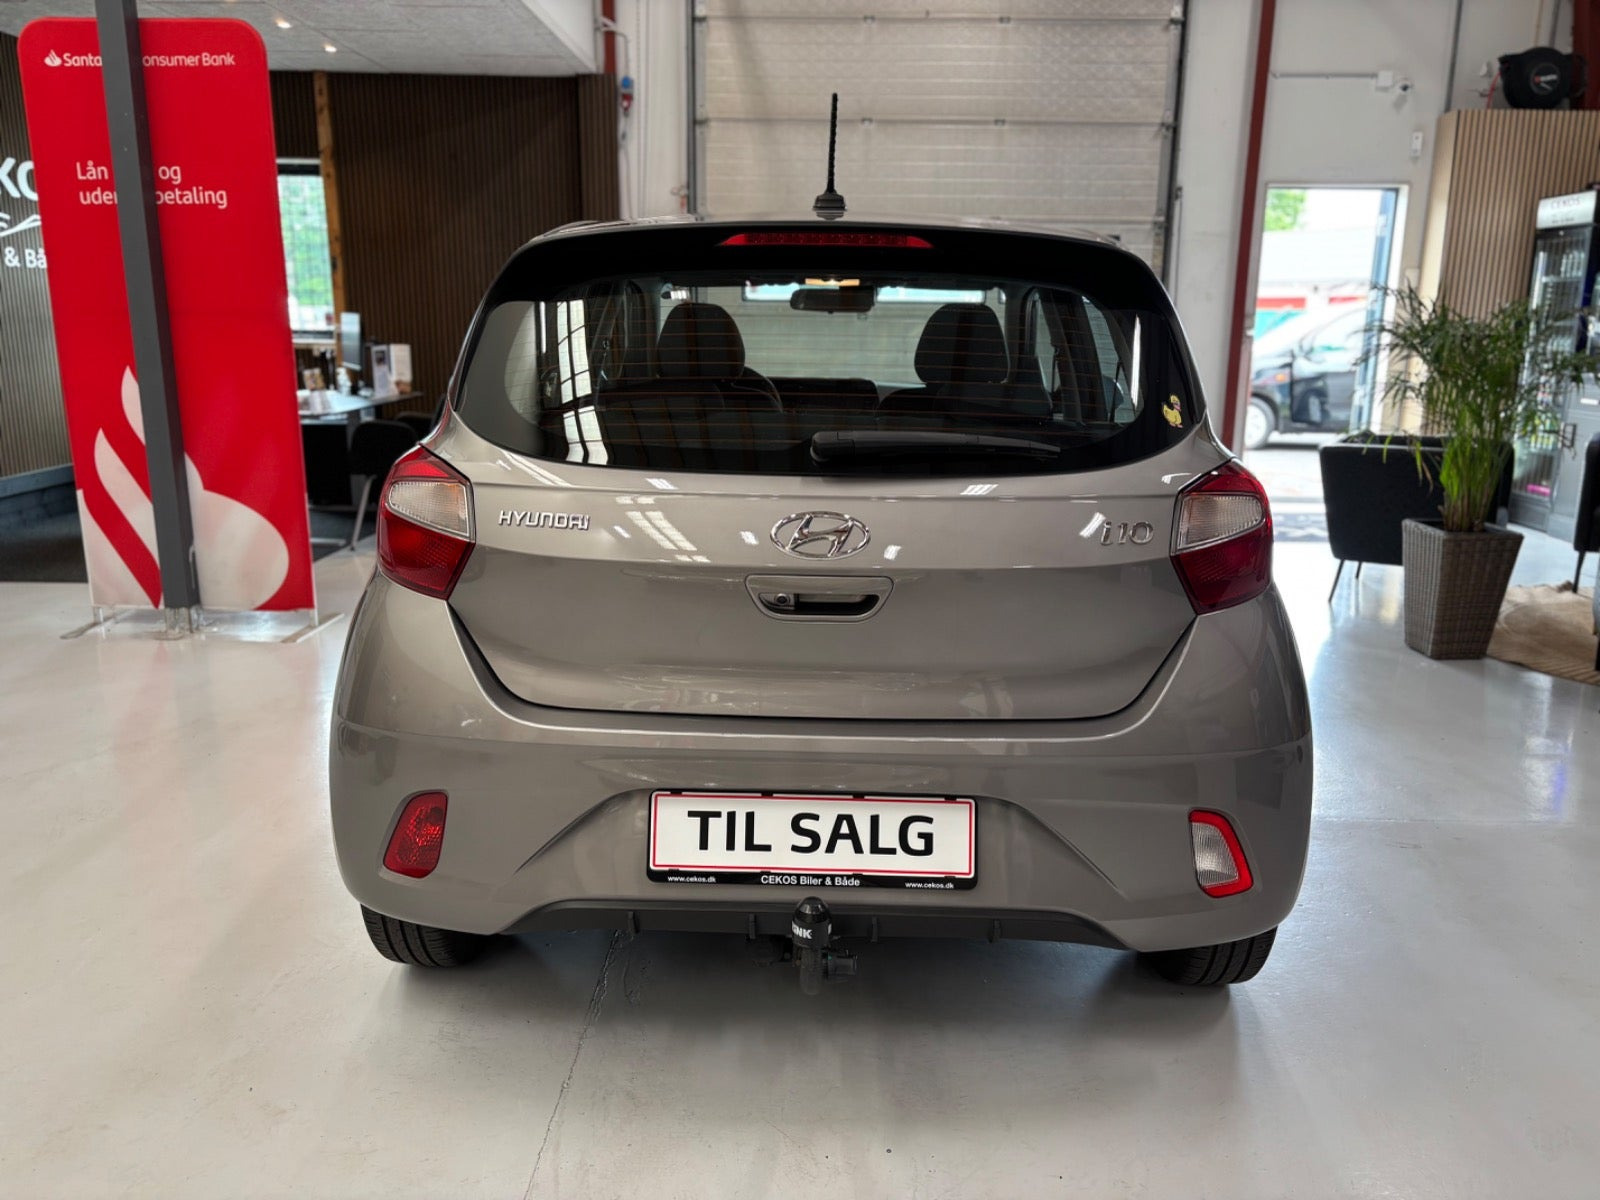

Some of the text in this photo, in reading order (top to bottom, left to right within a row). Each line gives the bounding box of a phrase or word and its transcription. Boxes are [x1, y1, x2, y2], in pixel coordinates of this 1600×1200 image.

[63, 52, 235, 66] Santa onsumer Bank
[76, 160, 181, 185] Lån og
[79, 187, 118, 205] ude
[4, 246, 47, 268] & Bå
[498, 509, 590, 531] HYUNDAI
[1100, 521, 1153, 545] i10
[688, 810, 934, 857] TIL SALG
[667, 875, 717, 884] www.cekos.dk
[760, 875, 861, 887] CEKOS Biler & Både
[905, 881, 955, 890] www.cekos.dk
